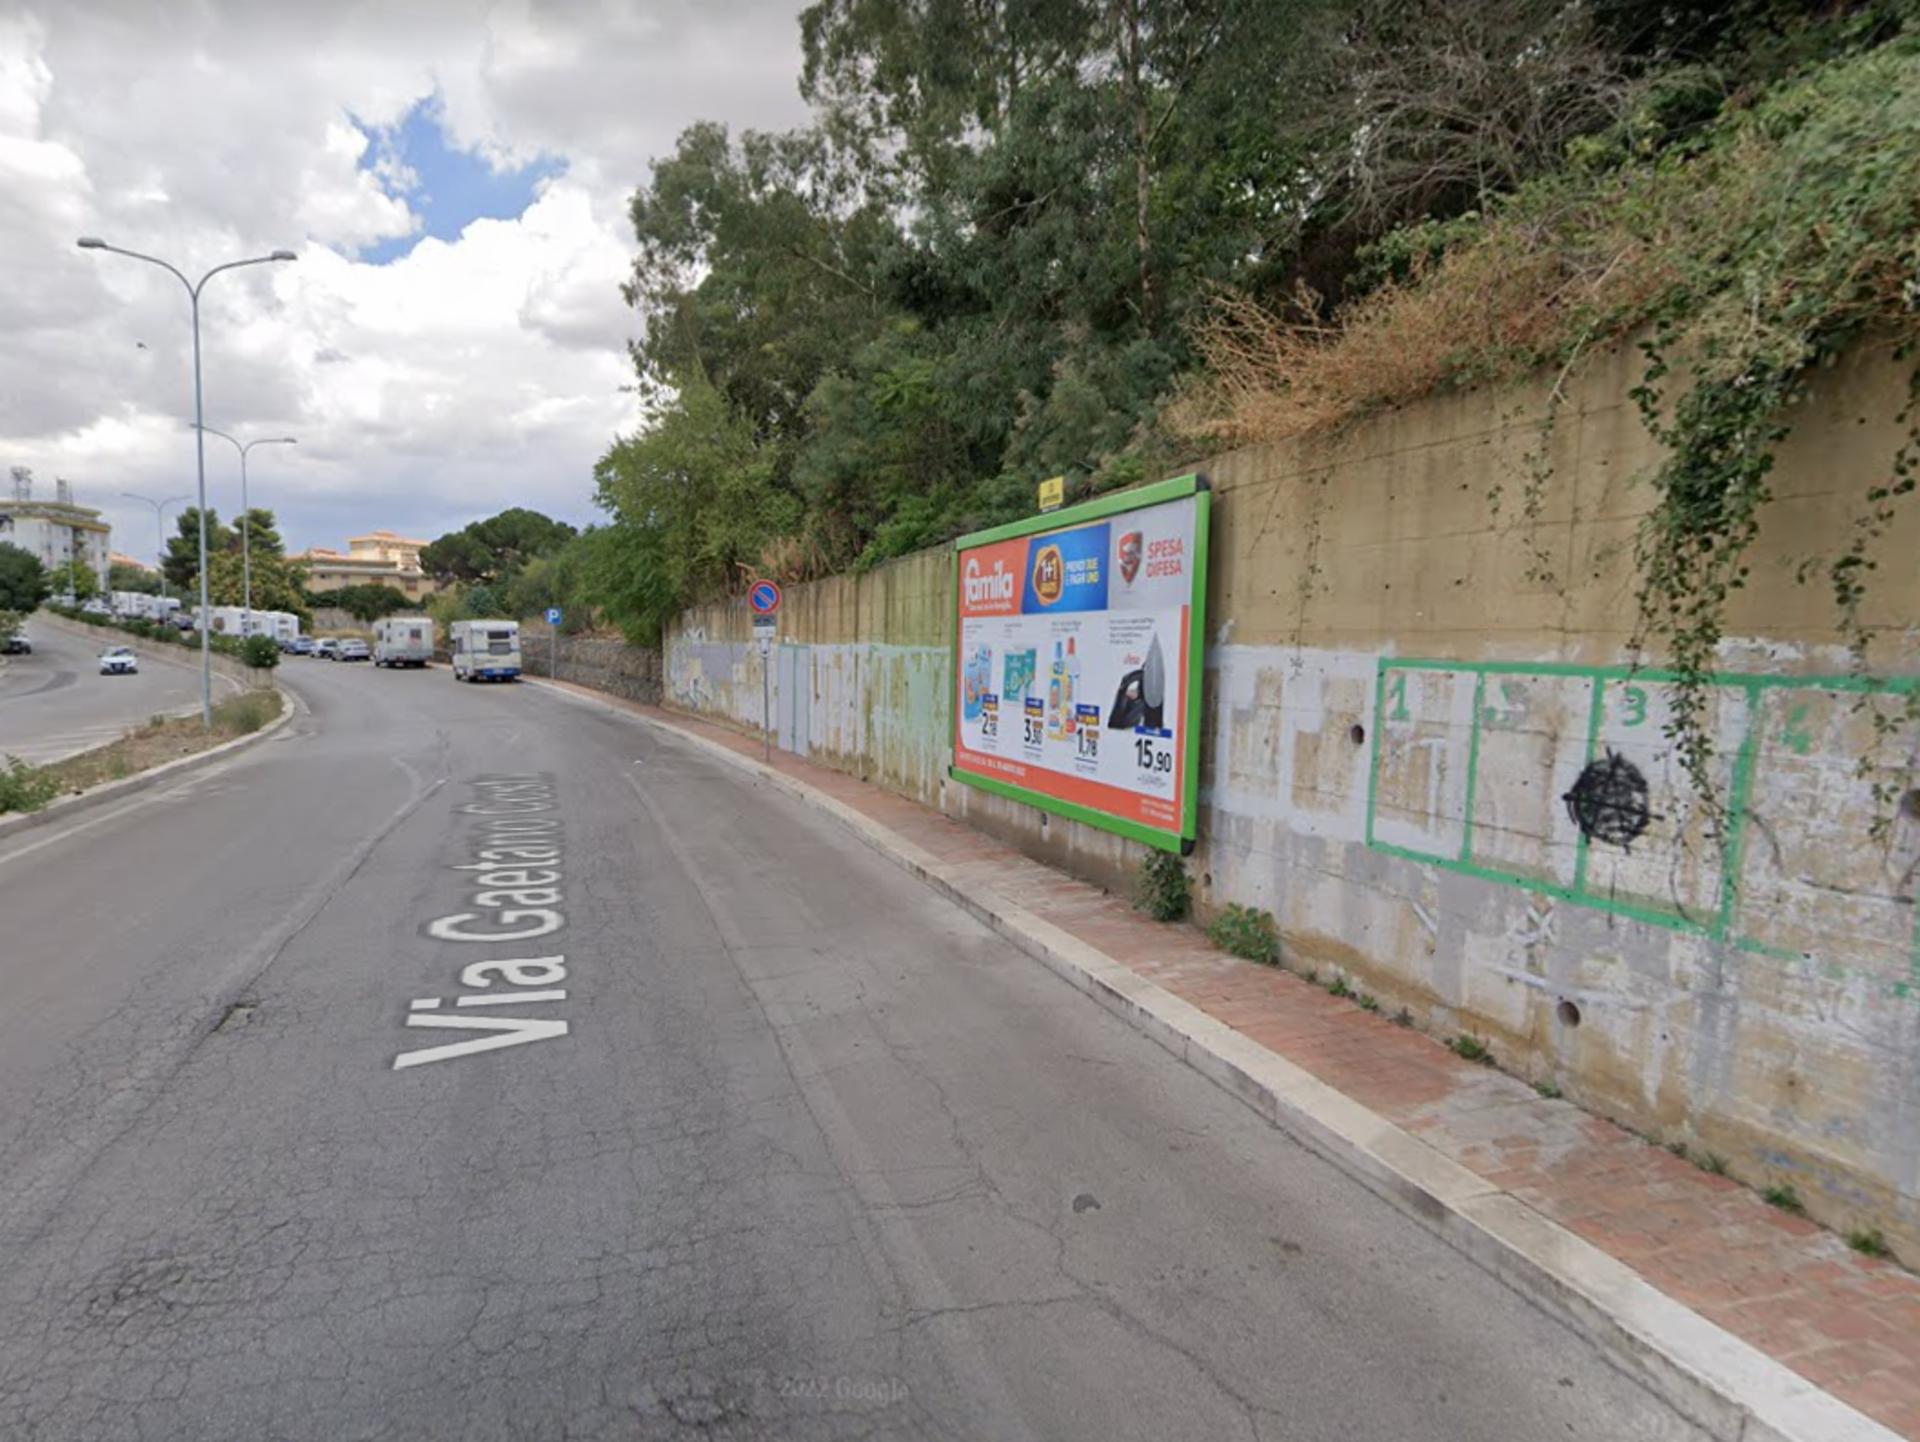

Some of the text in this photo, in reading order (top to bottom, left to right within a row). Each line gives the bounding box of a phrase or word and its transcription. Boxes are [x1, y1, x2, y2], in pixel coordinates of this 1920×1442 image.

[1147, 538, 1184, 560] SPESA
[964, 557, 1014, 606] famila
[1146, 559, 1182, 578] DIFESA
[548, 608, 560, 623] P
[1622, 687, 1646, 727] 3
[1134, 738, 1172, 773] 15,90
